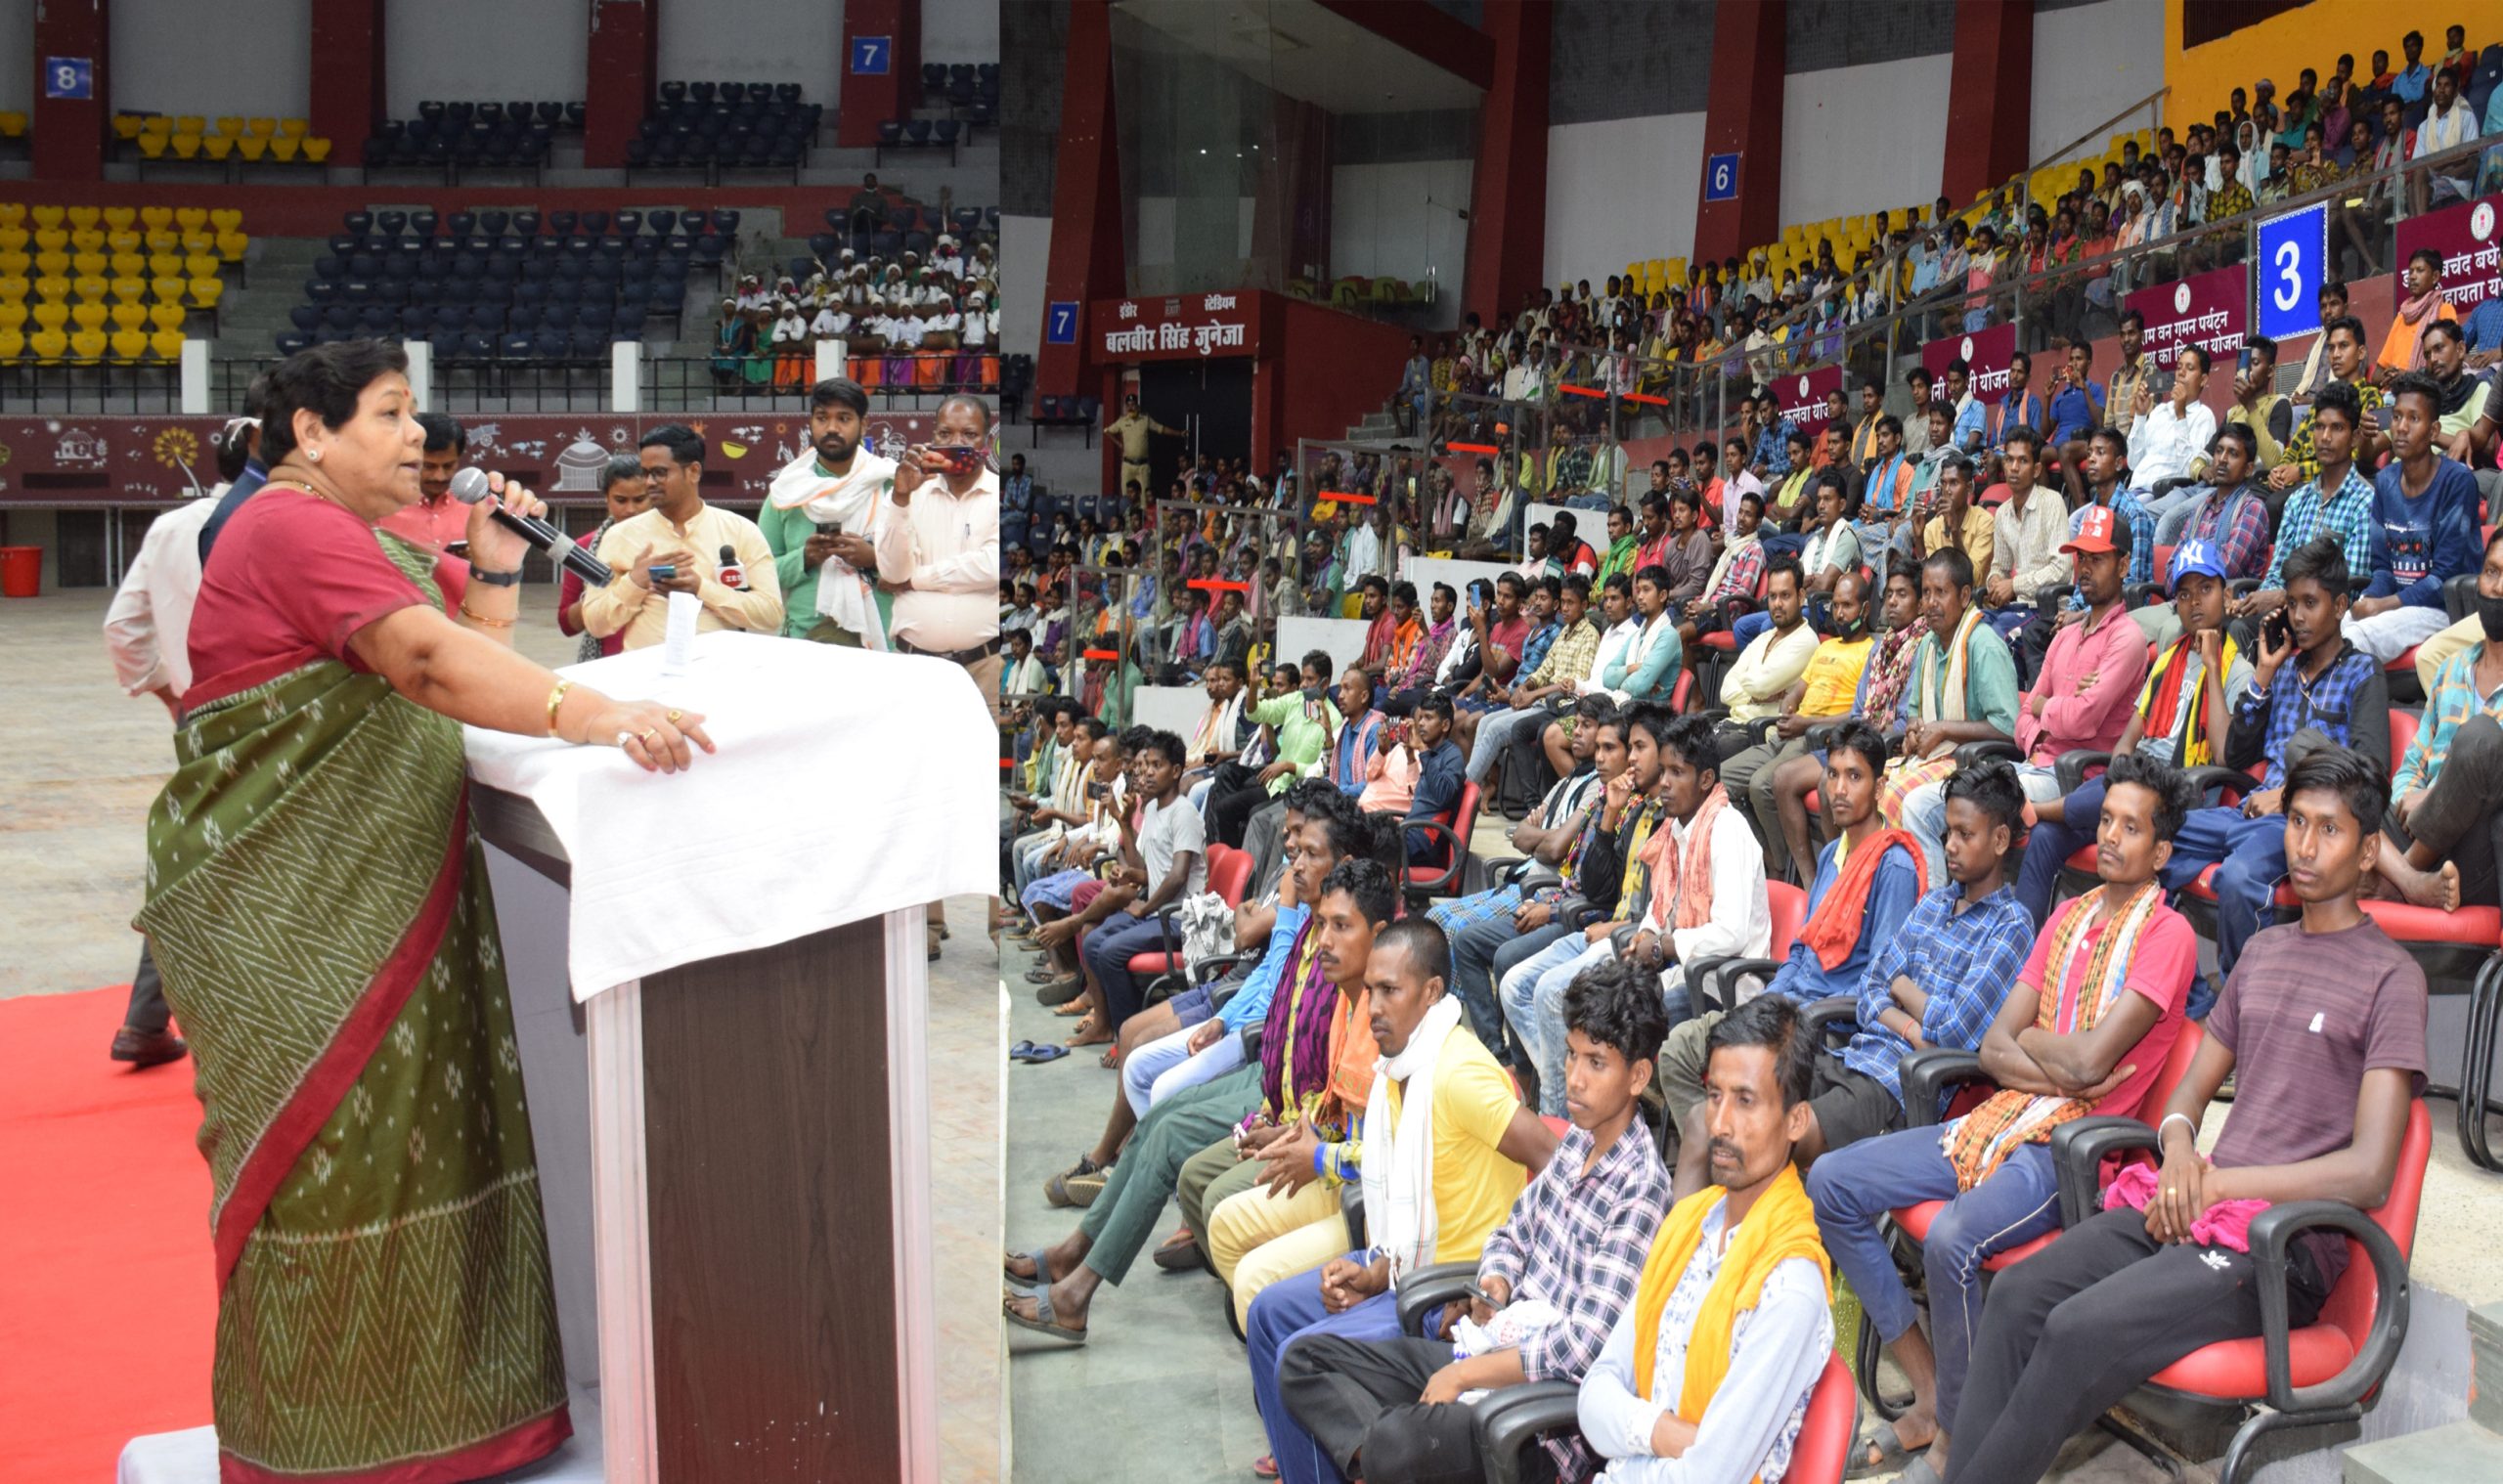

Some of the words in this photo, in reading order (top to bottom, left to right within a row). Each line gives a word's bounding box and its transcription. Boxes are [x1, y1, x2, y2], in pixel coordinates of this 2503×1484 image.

[862, 45, 878, 65] 7
[58, 66, 76, 90] 8
[1715, 163, 1729, 191] 6
[2475, 240, 2500, 269] बघे
[2273, 240, 2302, 311] 3
[1057, 311, 1070, 335] 7
[2157, 324, 2173, 341] वन
[2174, 318, 2197, 337] गमन
[2198, 306, 2229, 331] पर्यटन
[1106, 324, 1156, 353] बलबीर
[1160, 321, 1191, 351] सिंह
[1194, 319, 1246, 356] जुनेजा
[2158, 347, 2173, 365] का
[2210, 330, 2244, 354] योजना
[1979, 365, 2011, 392] योजन
